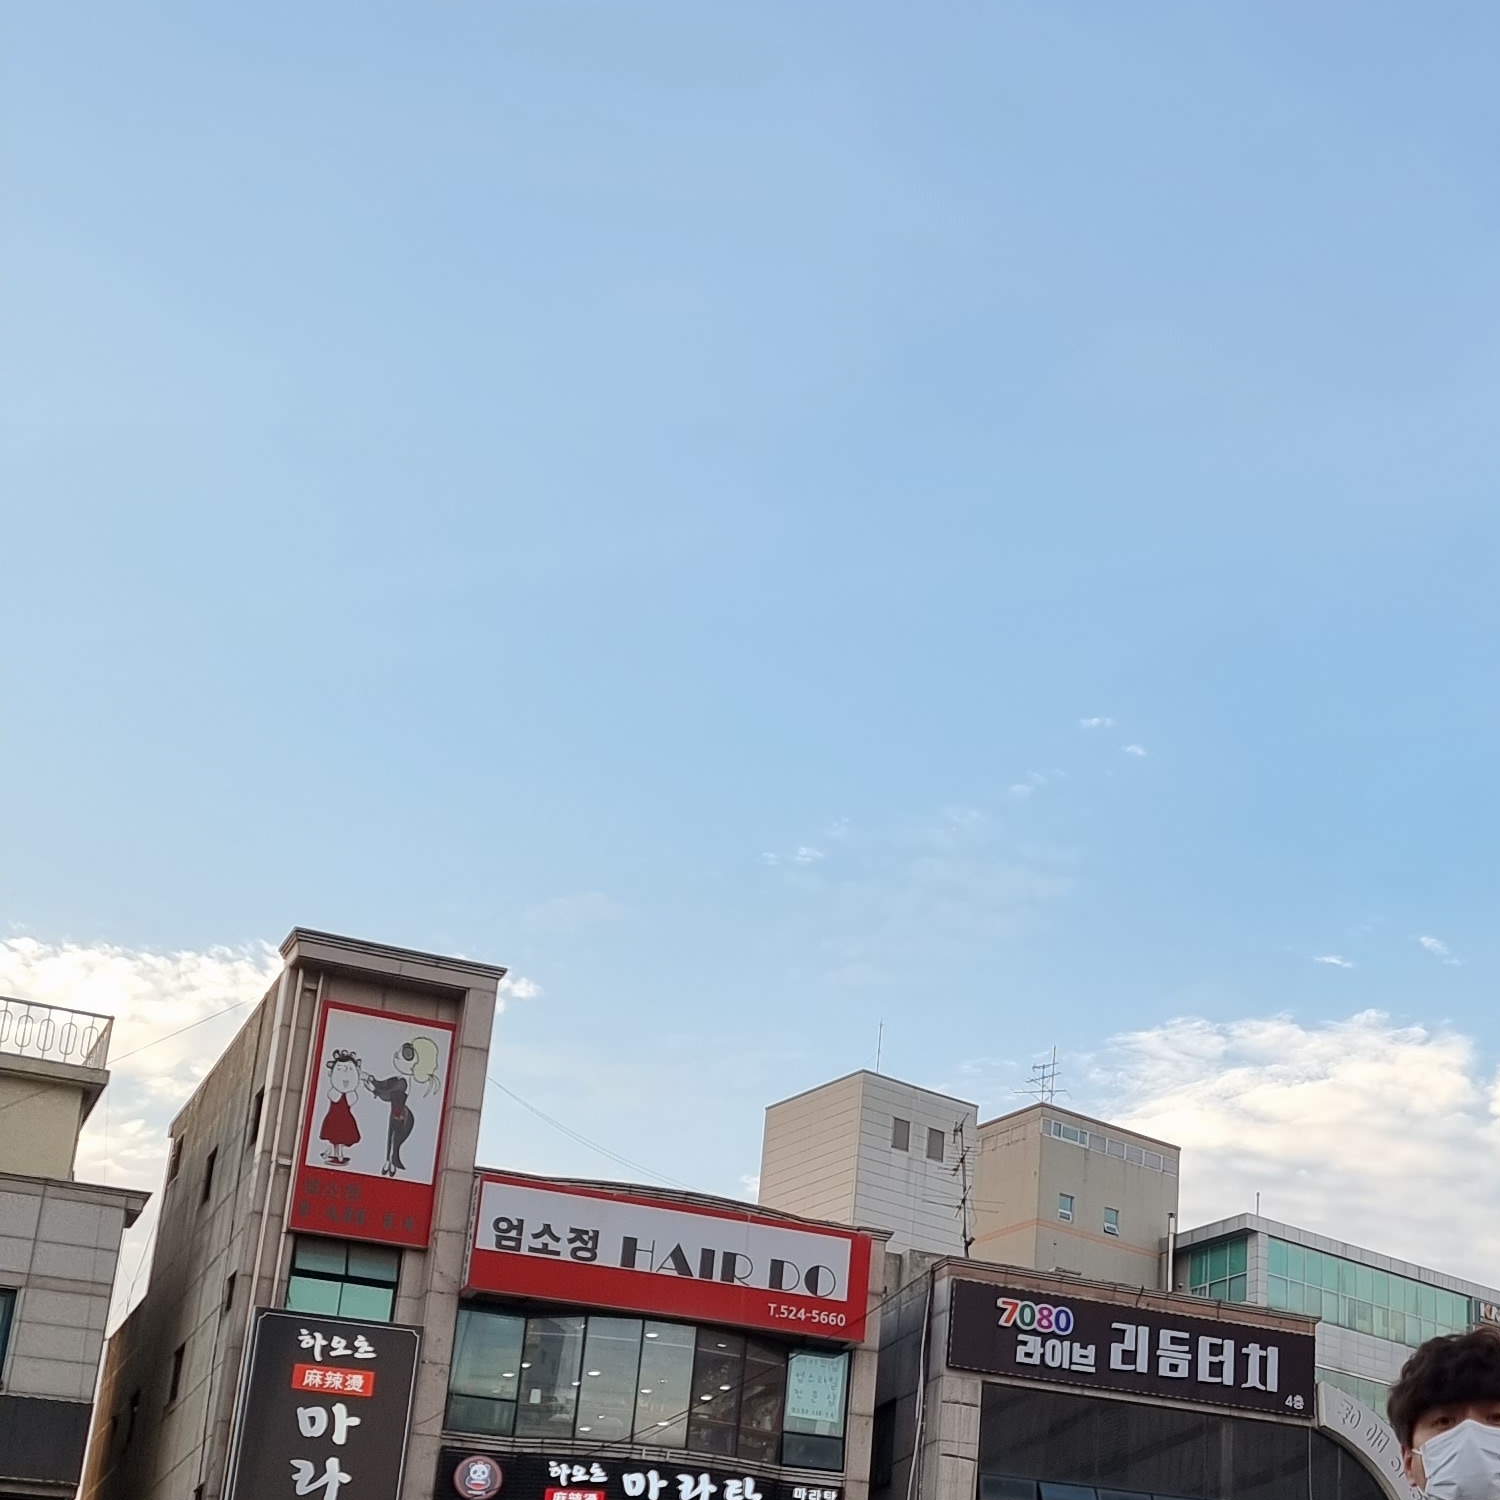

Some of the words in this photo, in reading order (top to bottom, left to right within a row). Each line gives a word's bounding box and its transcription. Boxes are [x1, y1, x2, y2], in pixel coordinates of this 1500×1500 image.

[492, 1216, 599, 1261] 엄소정
[620, 1236, 754, 1286] HAIR
[769, 1259, 836, 1297] DO
[768, 1303, 846, 1326] T.524-5660
[997, 1297, 1074, 1336] 7080
[1016, 1334, 1096, 1373] 라이브
[1110, 1322, 1279, 1393] 리듬터치
